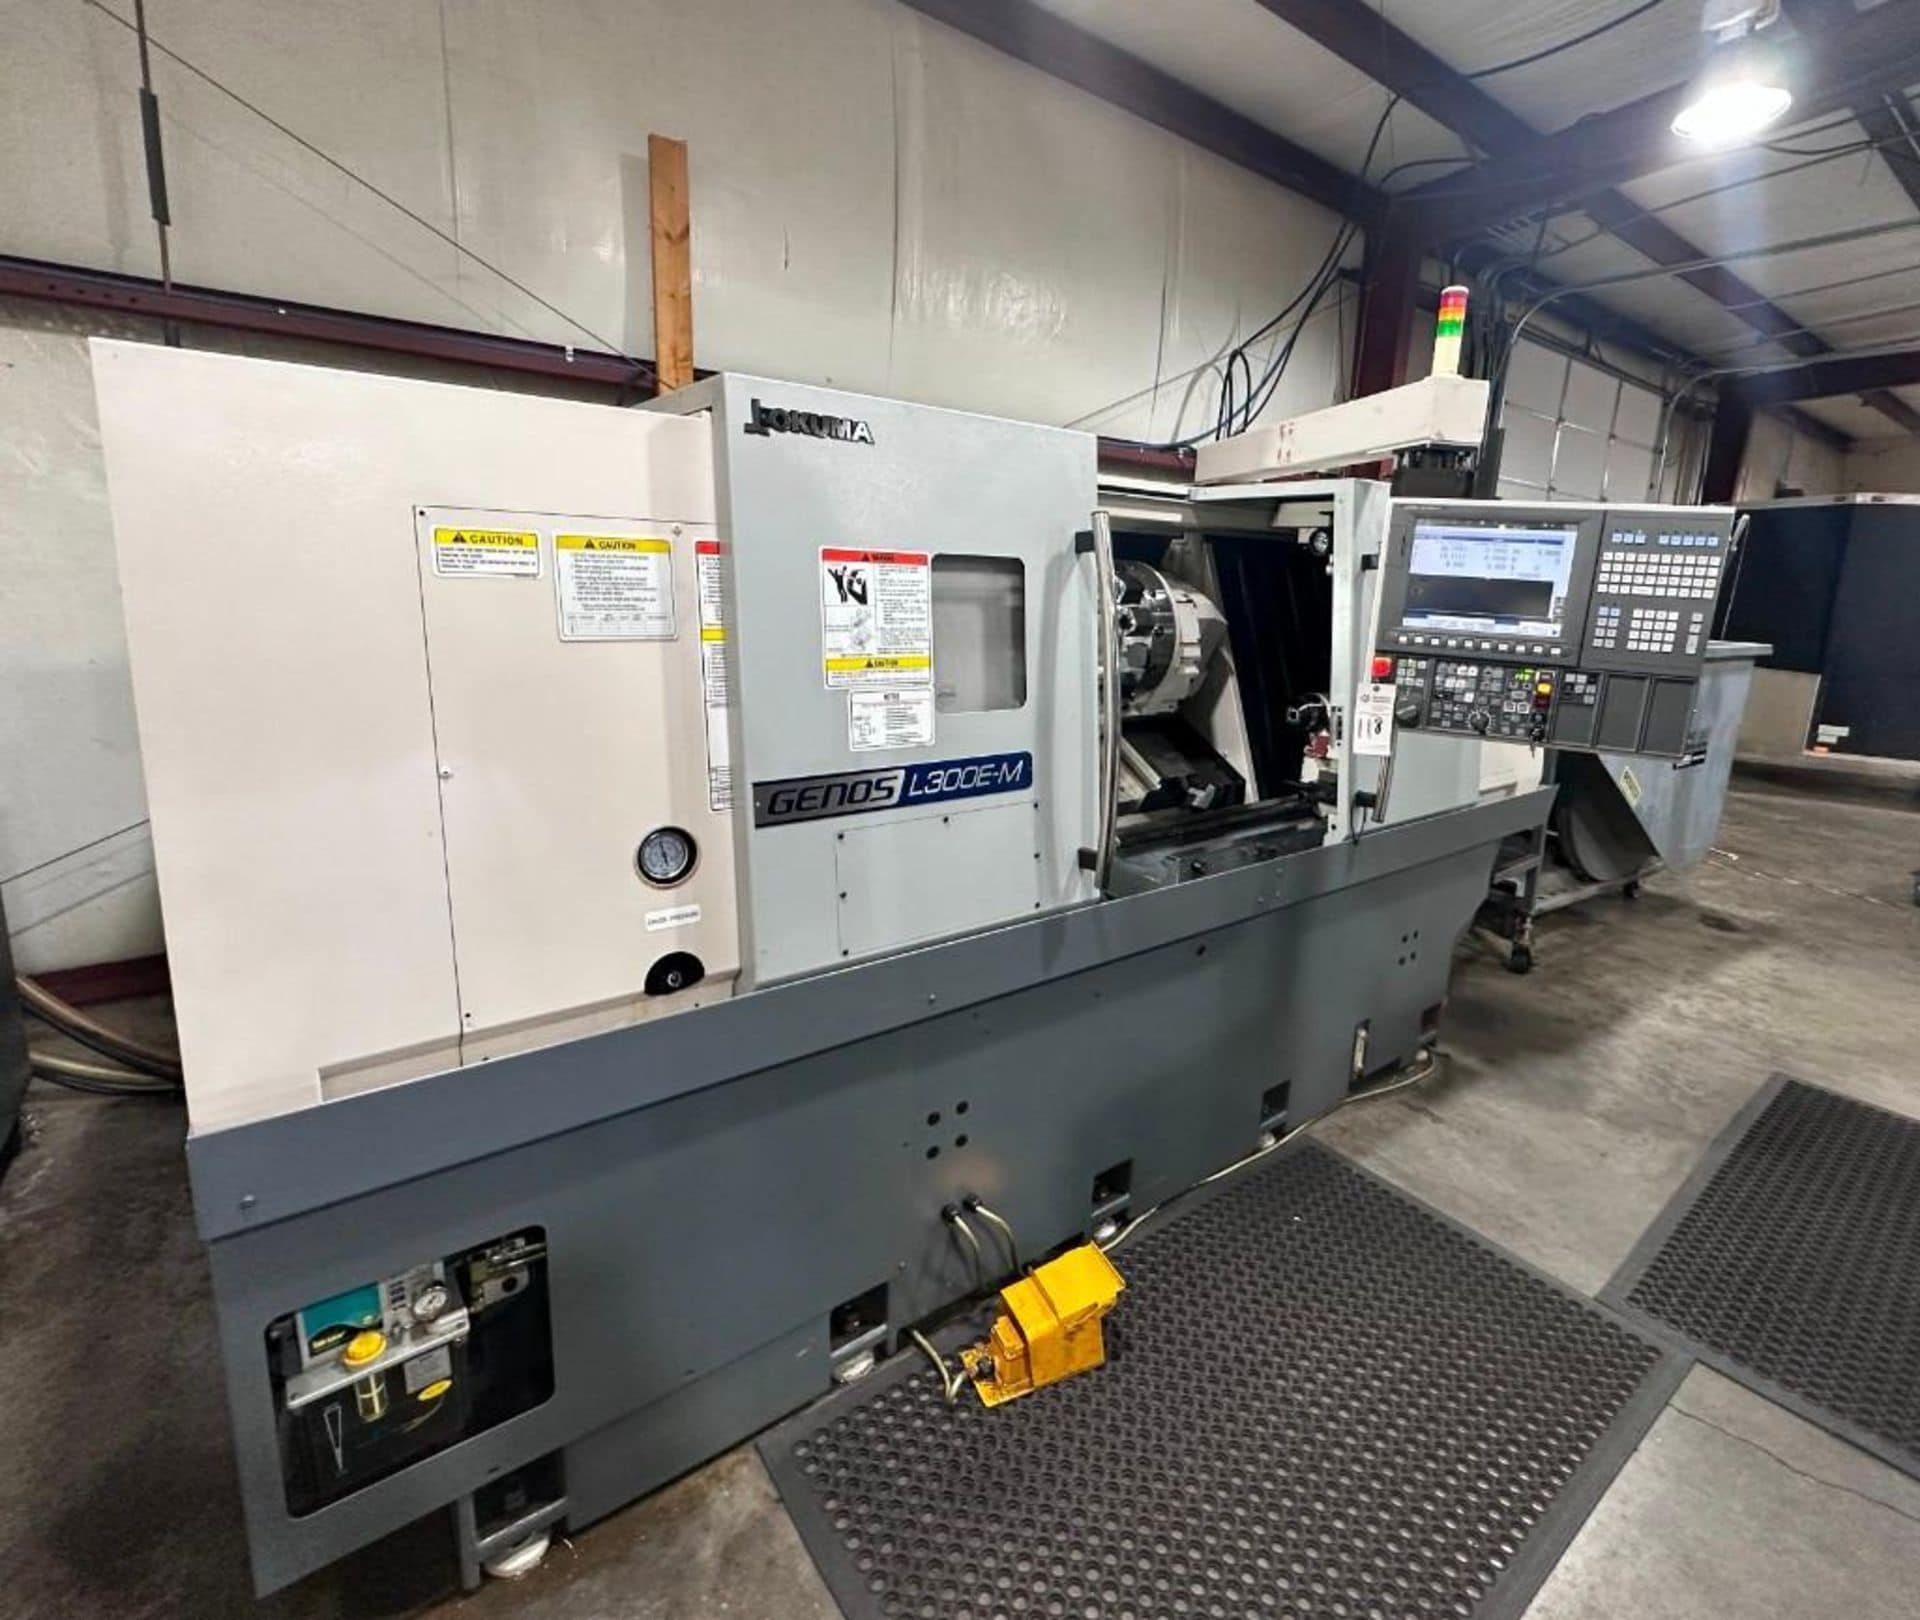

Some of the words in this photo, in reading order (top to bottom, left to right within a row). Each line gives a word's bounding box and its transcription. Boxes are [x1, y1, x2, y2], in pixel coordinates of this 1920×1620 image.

[768, 408, 876, 445] OKUMA
[468, 533, 524, 547] CAUTION
[598, 540, 637, 551] CAUTION
[767, 774, 899, 816] GENOS
[907, 760, 1025, 797] L300E-M
